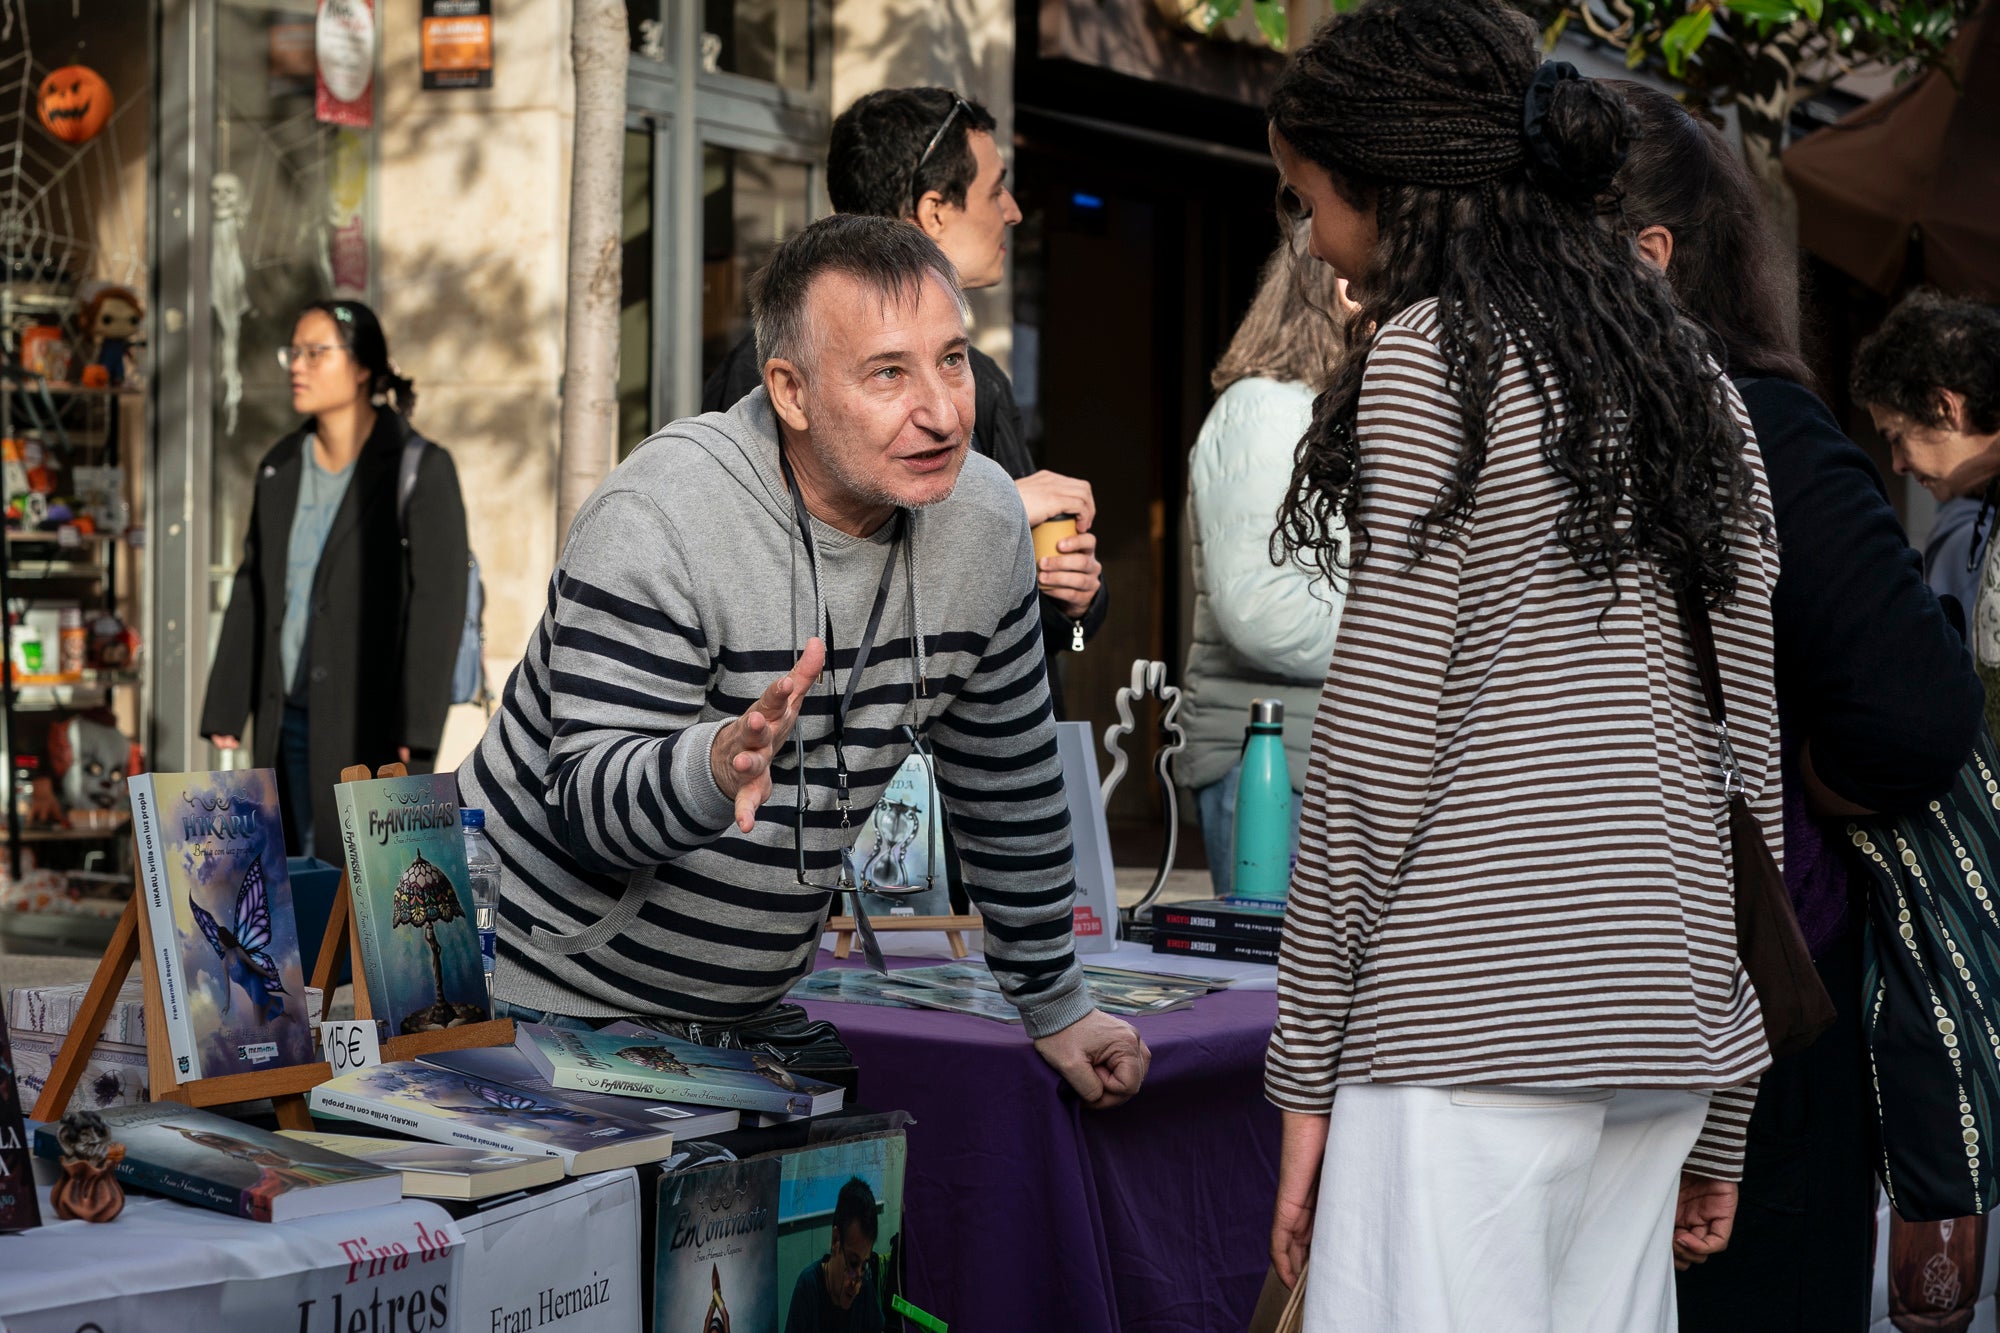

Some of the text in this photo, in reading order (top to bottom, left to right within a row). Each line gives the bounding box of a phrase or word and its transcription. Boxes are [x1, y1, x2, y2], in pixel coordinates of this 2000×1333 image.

[139, 792, 150, 819] propia
[182, 809, 257, 841] HIKARU
[145, 834, 153, 850] con
[147, 851, 157, 872] brilla
[151, 872, 161, 908] HIKARU,
[328, 1026, 366, 1070] 15€
[321, 1098, 344, 1110] propia
[356, 1106, 370, 1115] con
[370, 1110, 389, 1121] brilla
[389, 1114, 419, 1128] HIKARU,
[338, 1221, 453, 1285] Fira de
[490, 1271, 610, 1333] Fran Hernaiz
